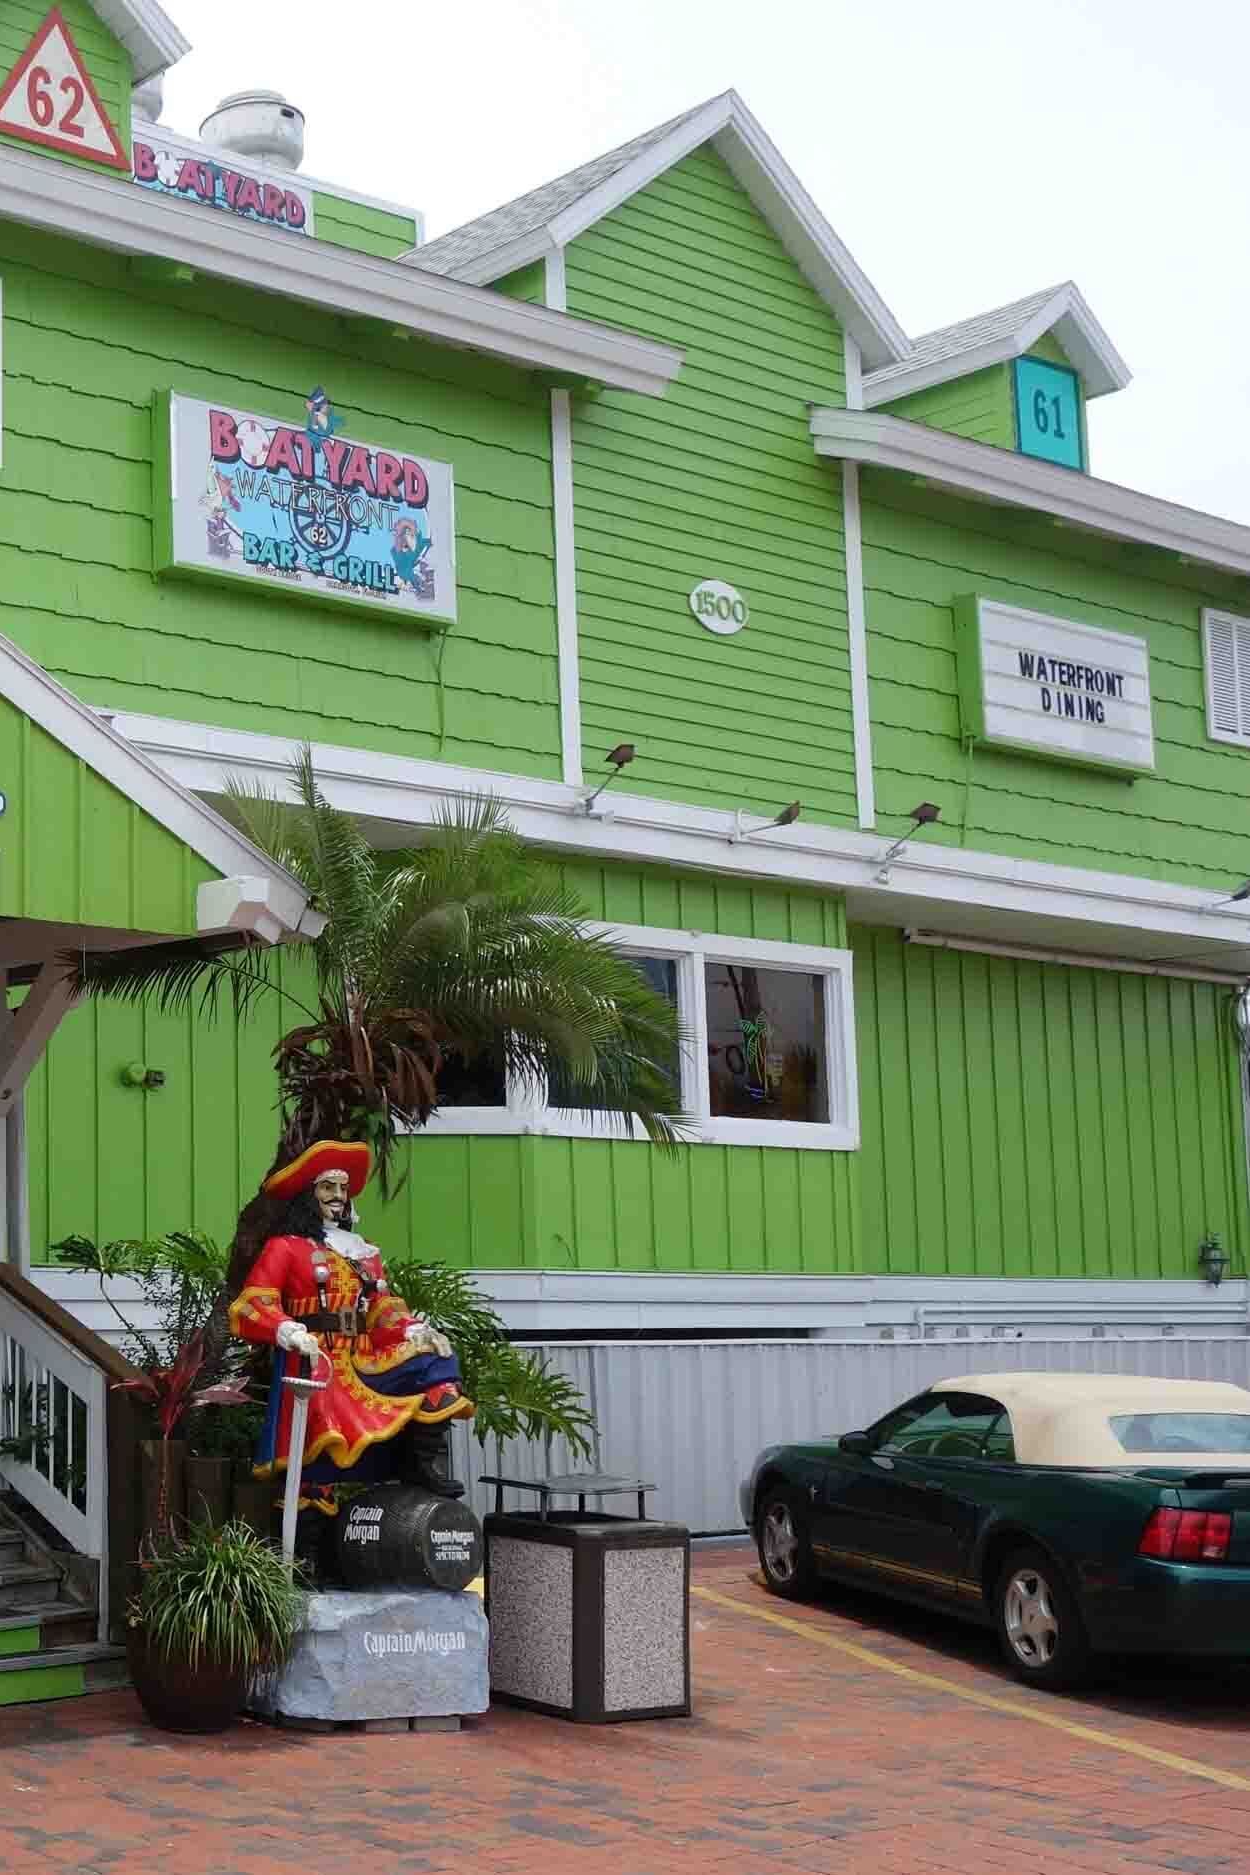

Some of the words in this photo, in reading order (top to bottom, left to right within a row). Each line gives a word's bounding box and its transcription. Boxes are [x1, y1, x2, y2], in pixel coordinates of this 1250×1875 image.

[26, 65, 85, 139] 62
[133, 142, 306, 229] BOATYARD
[1033, 388, 1066, 440] 61
[209, 409, 430, 508] BOATYARD
[235, 467, 400, 529] WATERFRONT
[309, 525, 329, 545] 62
[243, 532, 300, 569] BAR
[333, 555, 400, 593] GRILL
[694, 591, 746, 624] 1500
[1018, 650, 1124, 698] WATERFRONT
[1041, 687, 1105, 724] DINING
[344, 1523, 380, 1544] Morgan
[350, 1505, 384, 1524] Captain
[364, 1631, 414, 1657] Captain
[414, 1629, 466, 1656] Morgan
